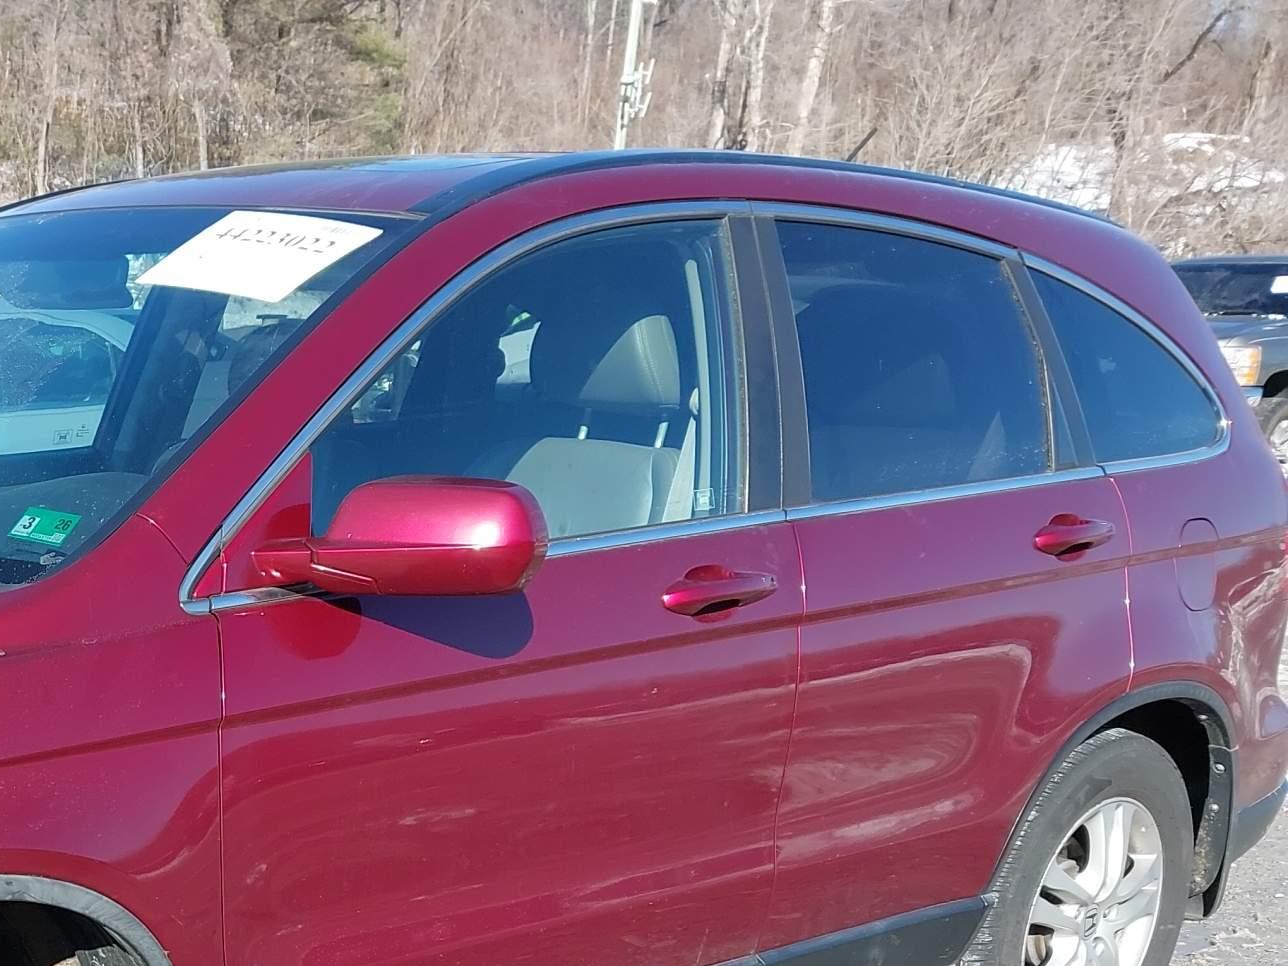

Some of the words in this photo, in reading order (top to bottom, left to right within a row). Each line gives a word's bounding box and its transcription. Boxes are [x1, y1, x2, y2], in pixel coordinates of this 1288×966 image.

[215, 227, 336, 254] 44223022
[23, 516, 36, 529] 3
[54, 518, 73, 531] 26
